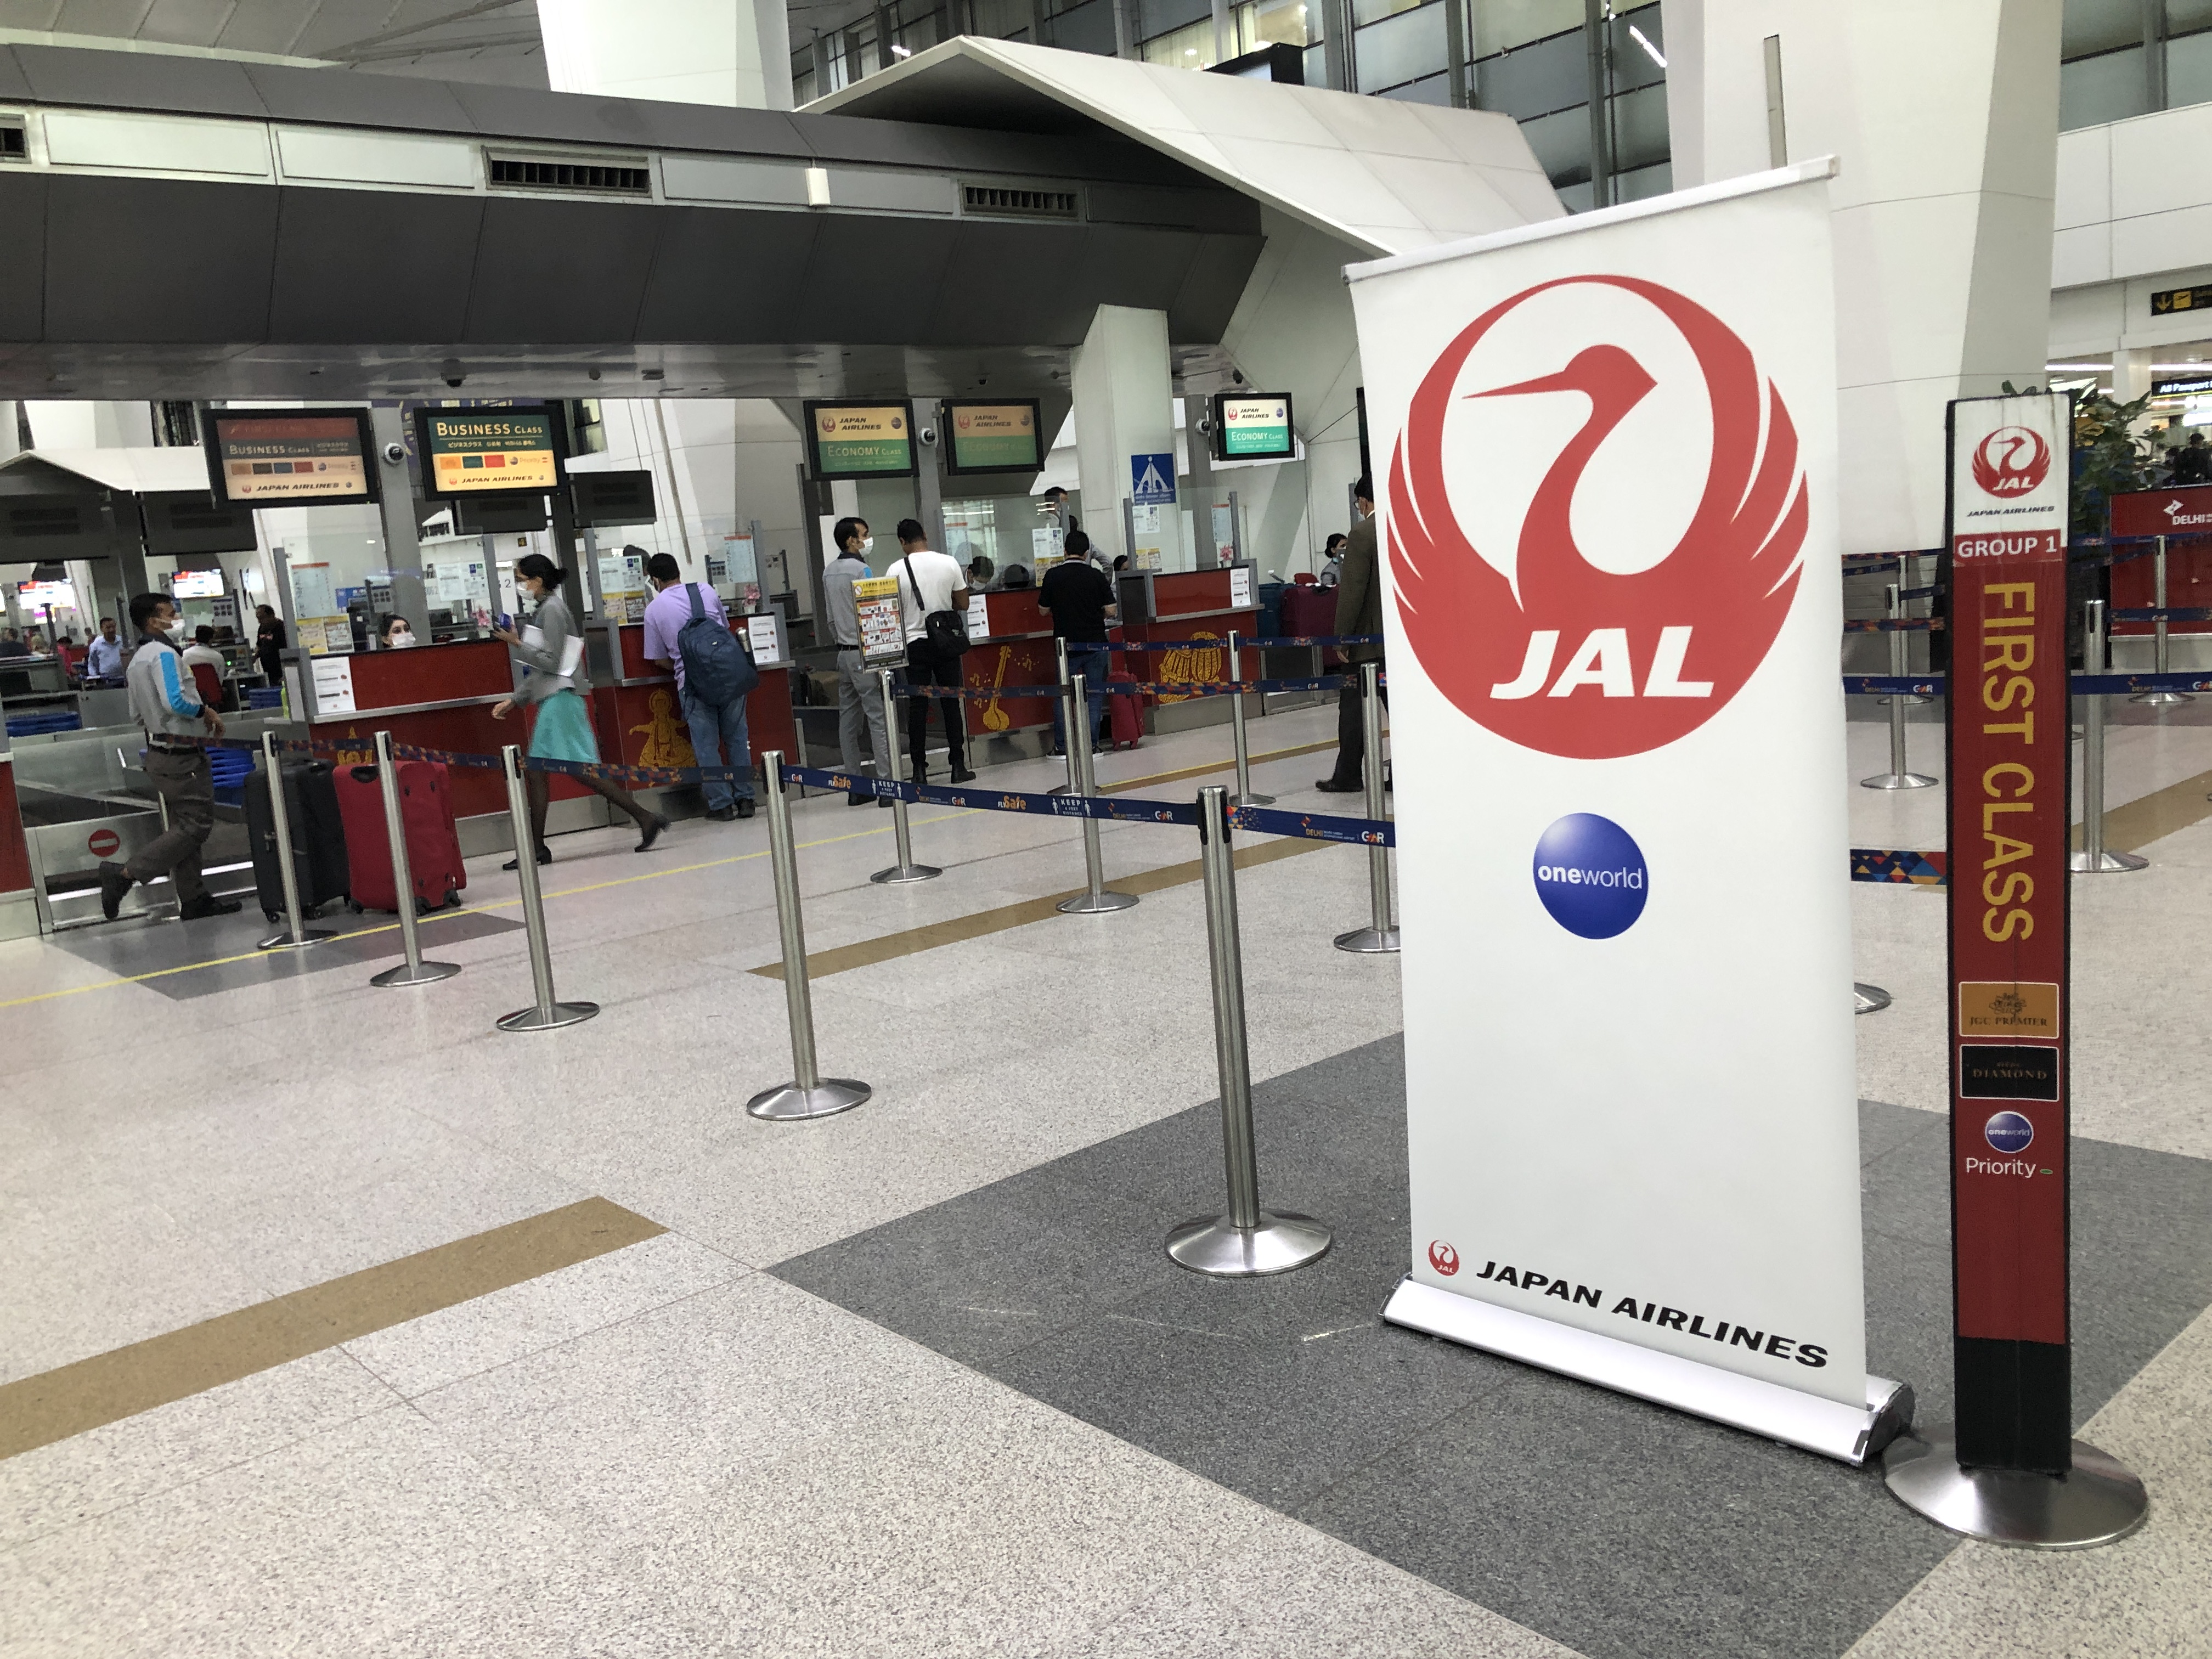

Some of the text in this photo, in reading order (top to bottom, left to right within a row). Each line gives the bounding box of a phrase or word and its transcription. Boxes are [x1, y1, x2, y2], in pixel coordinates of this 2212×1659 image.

[436, 422, 543, 436] BUSINESS CLASS
[1231, 431, 1268, 441] ECONOMY
[229, 444, 285, 455] BUSINESS
[827, 445, 880, 457] ECONOMY
[1992, 476, 2034, 491] JAL
[1966, 506, 2055, 517] JAPAN AIRLINES
[2172, 514, 2206, 525] DELHI
[1957, 535, 2058, 558] GROUP 1
[1489, 625, 1714, 699] JAL
[1982, 582, 2035, 943] FIRST CLASS
[833, 775, 851, 789] Safe
[1003, 795, 1026, 810] Safe
[1306, 828, 1324, 837] DELHI
[1538, 865, 1643, 889] oneworld
[1970, 1017, 2047, 1027] JGC PREMIER
[1972, 1068, 2047, 1080] DIAMOND
[1988, 1128, 2030, 1137] oneworld
[1966, 1157, 2036, 1178] Priority
[1437, 1265, 1454, 1273] JAL
[1476, 1261, 1829, 1368] JAPAN AIRLINES
